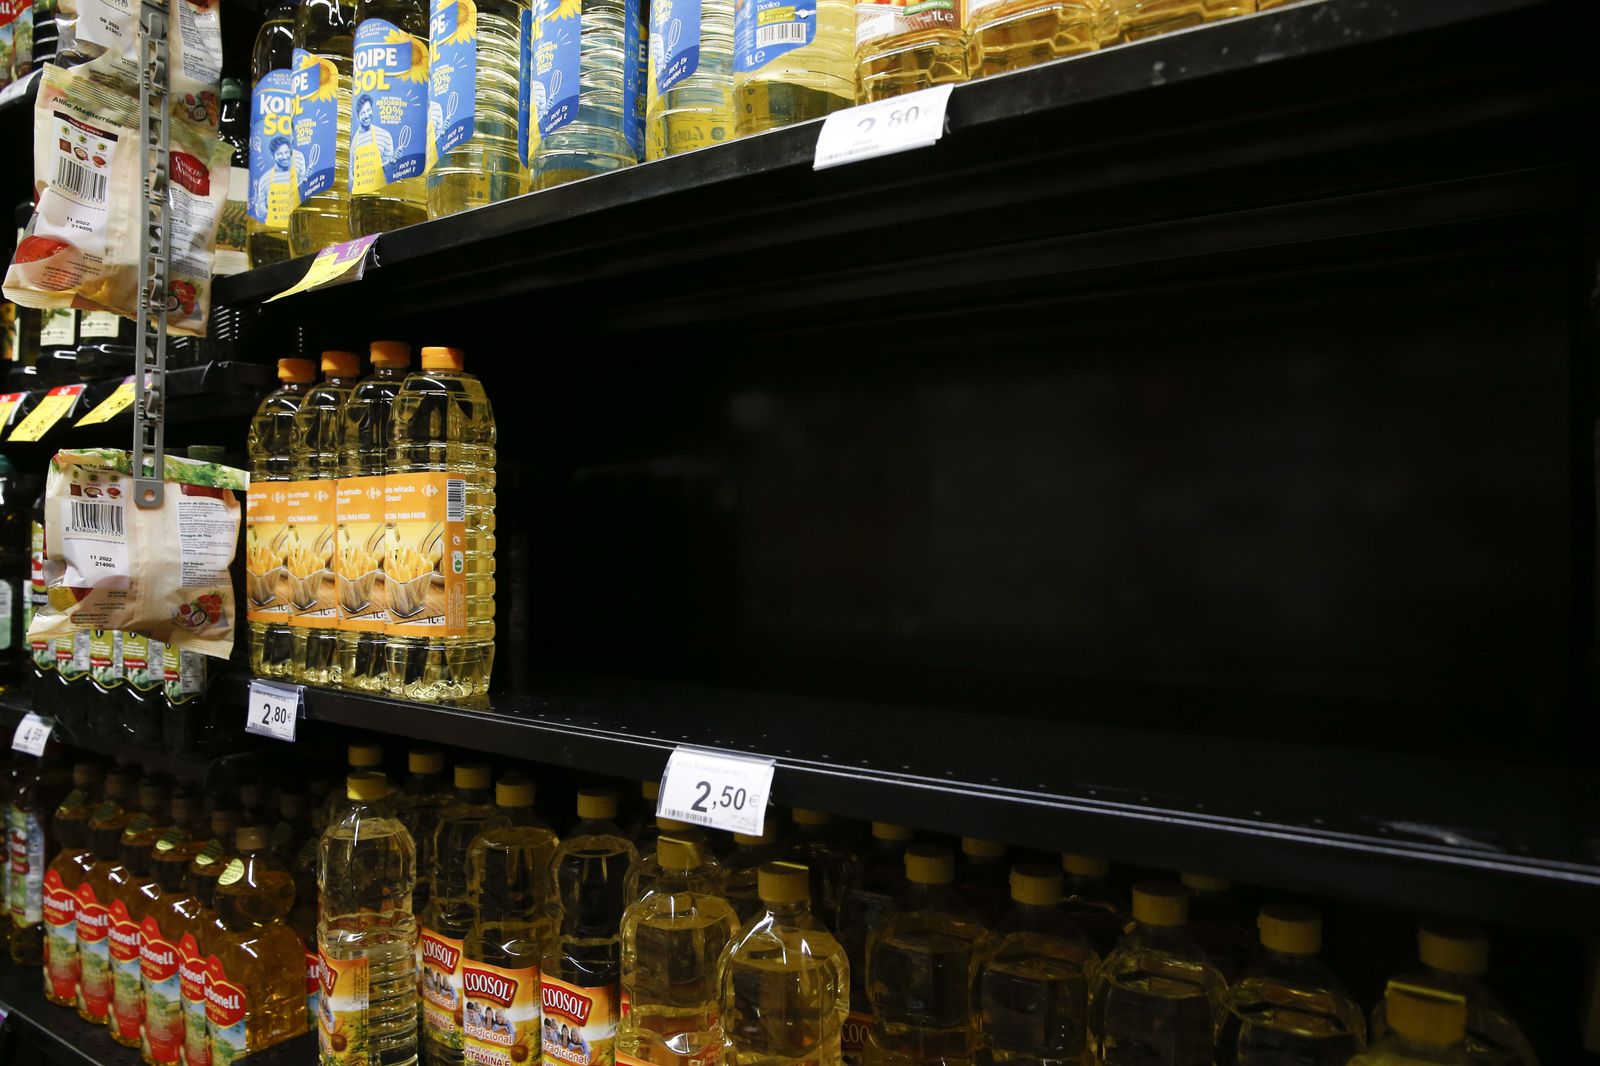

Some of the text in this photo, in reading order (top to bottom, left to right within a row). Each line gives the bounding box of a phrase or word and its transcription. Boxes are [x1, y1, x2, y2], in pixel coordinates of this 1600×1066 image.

[354, 68, 390, 96] SOL
[260, 94, 292, 117] KOI
[379, 105, 403, 116] 20%
[264, 113, 292, 137] SO
[75, 219, 90, 227] 2022
[43, 894, 75, 912] rbonell
[75, 910, 109, 927] rbonell
[108, 926, 141, 946] rbonell
[140, 944, 175, 965] rbonell
[423, 939, 453, 969] COOSOL
[179, 963, 206, 985] rbonel
[204, 985, 240, 1010] rbonell
[465, 973, 511, 1002] COOSOL
[542, 987, 585, 1020] COOSOL
[466, 1024, 514, 1044] Tradicional
[841, 1023, 870, 1046] COO
[465, 1048, 502, 1066] VITAMINA
[544, 1041, 588, 1065] Tradicional
